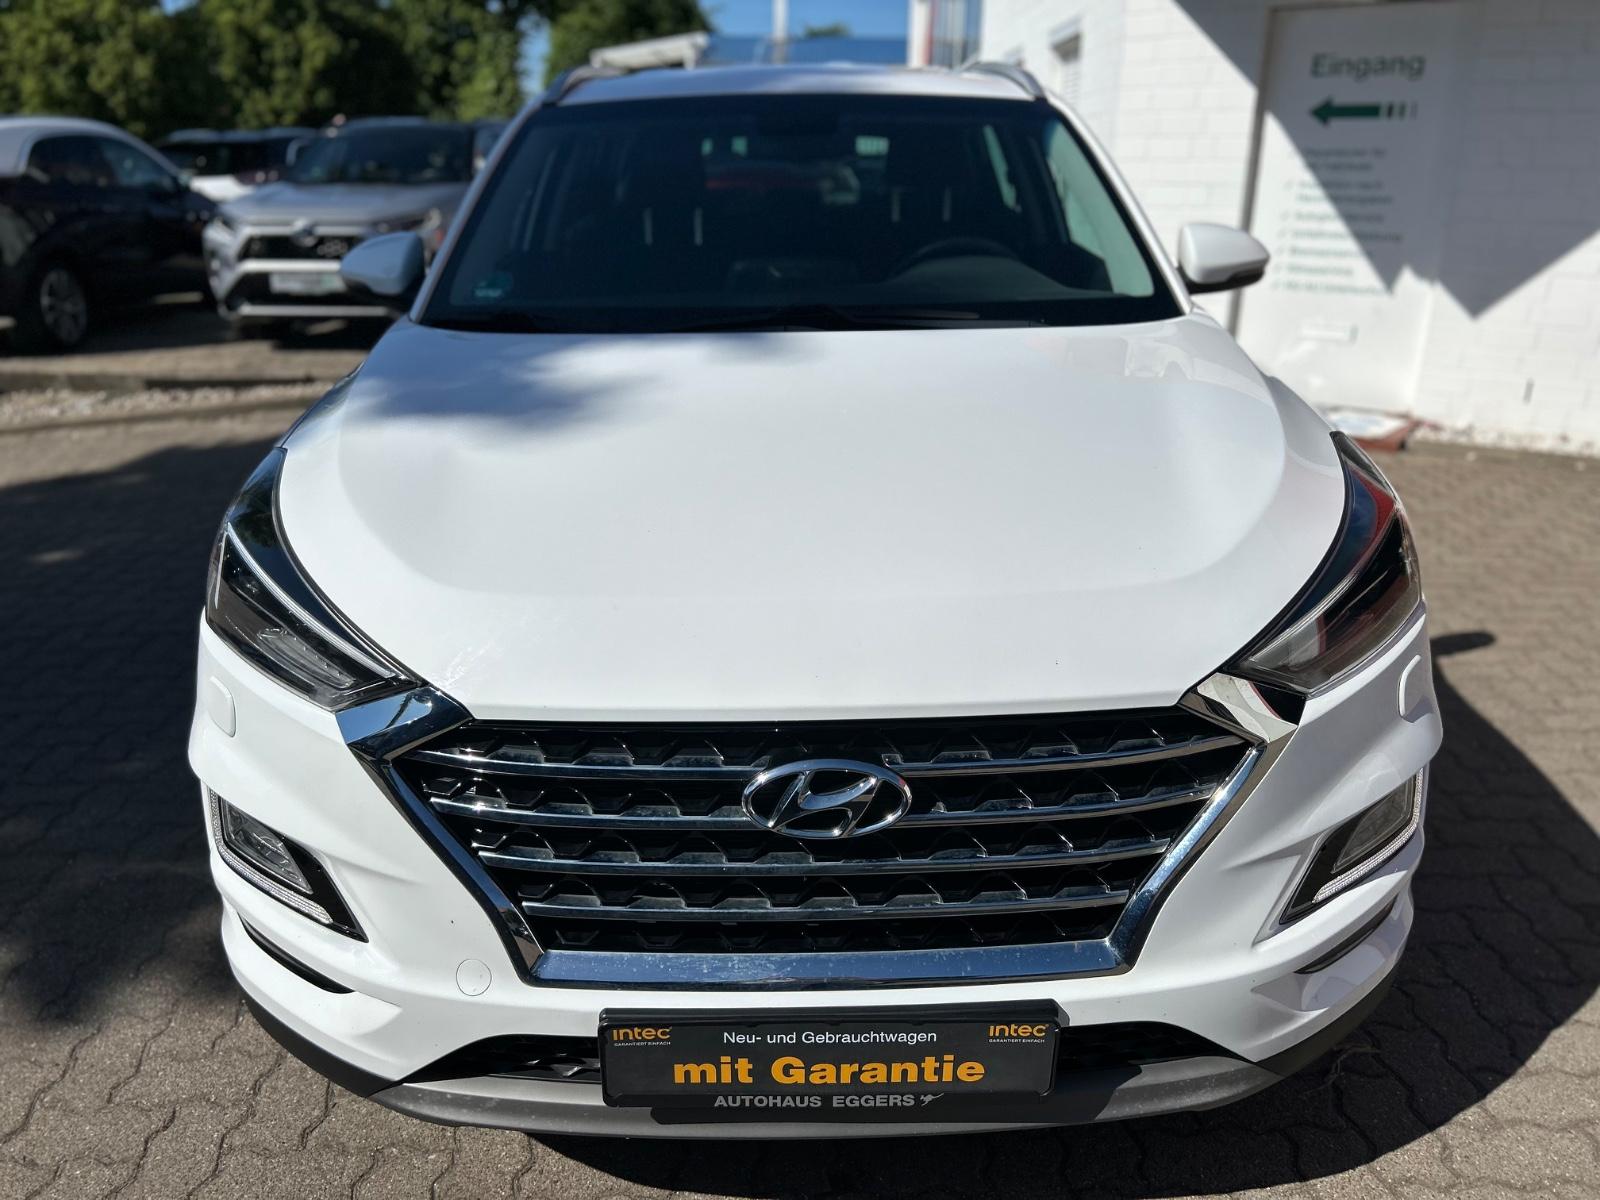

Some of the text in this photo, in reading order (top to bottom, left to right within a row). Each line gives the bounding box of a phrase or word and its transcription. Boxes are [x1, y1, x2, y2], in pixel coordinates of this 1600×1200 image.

[1310, 53, 1426, 82] Eingang
[723, 1030, 938, 1045] Neu- und Gebrauchtwagen
[673, 1053, 986, 1085] mit Garantie
[714, 1093, 915, 1108] AUTOHAUS EGGERS
